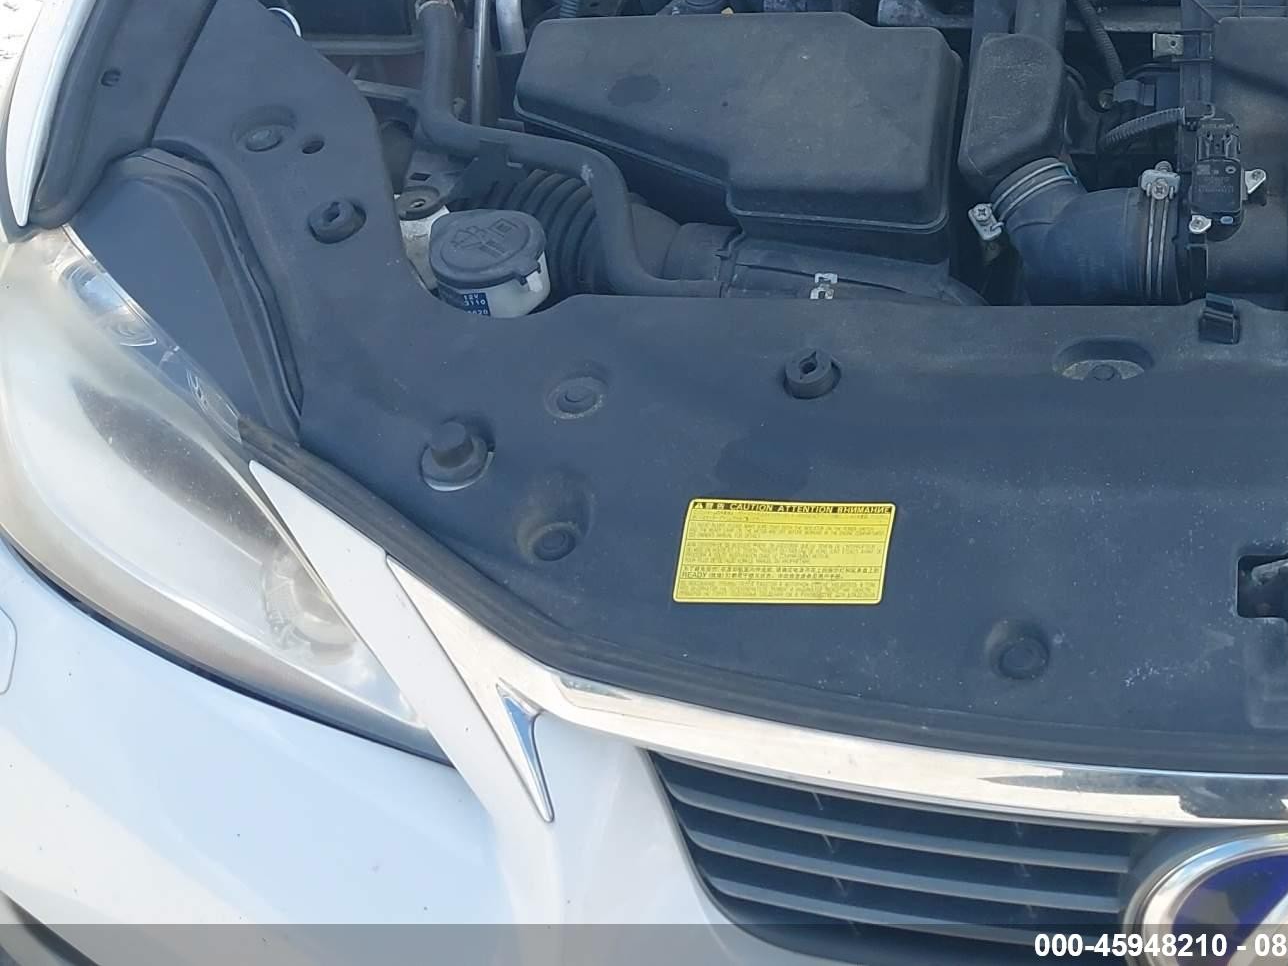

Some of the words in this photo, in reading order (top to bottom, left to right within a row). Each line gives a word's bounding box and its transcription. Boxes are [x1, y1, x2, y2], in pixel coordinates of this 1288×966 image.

[729, 503, 773, 511] CAUTION
[777, 505, 833, 513] ATTENTION
[681, 571, 707, 579] READY
